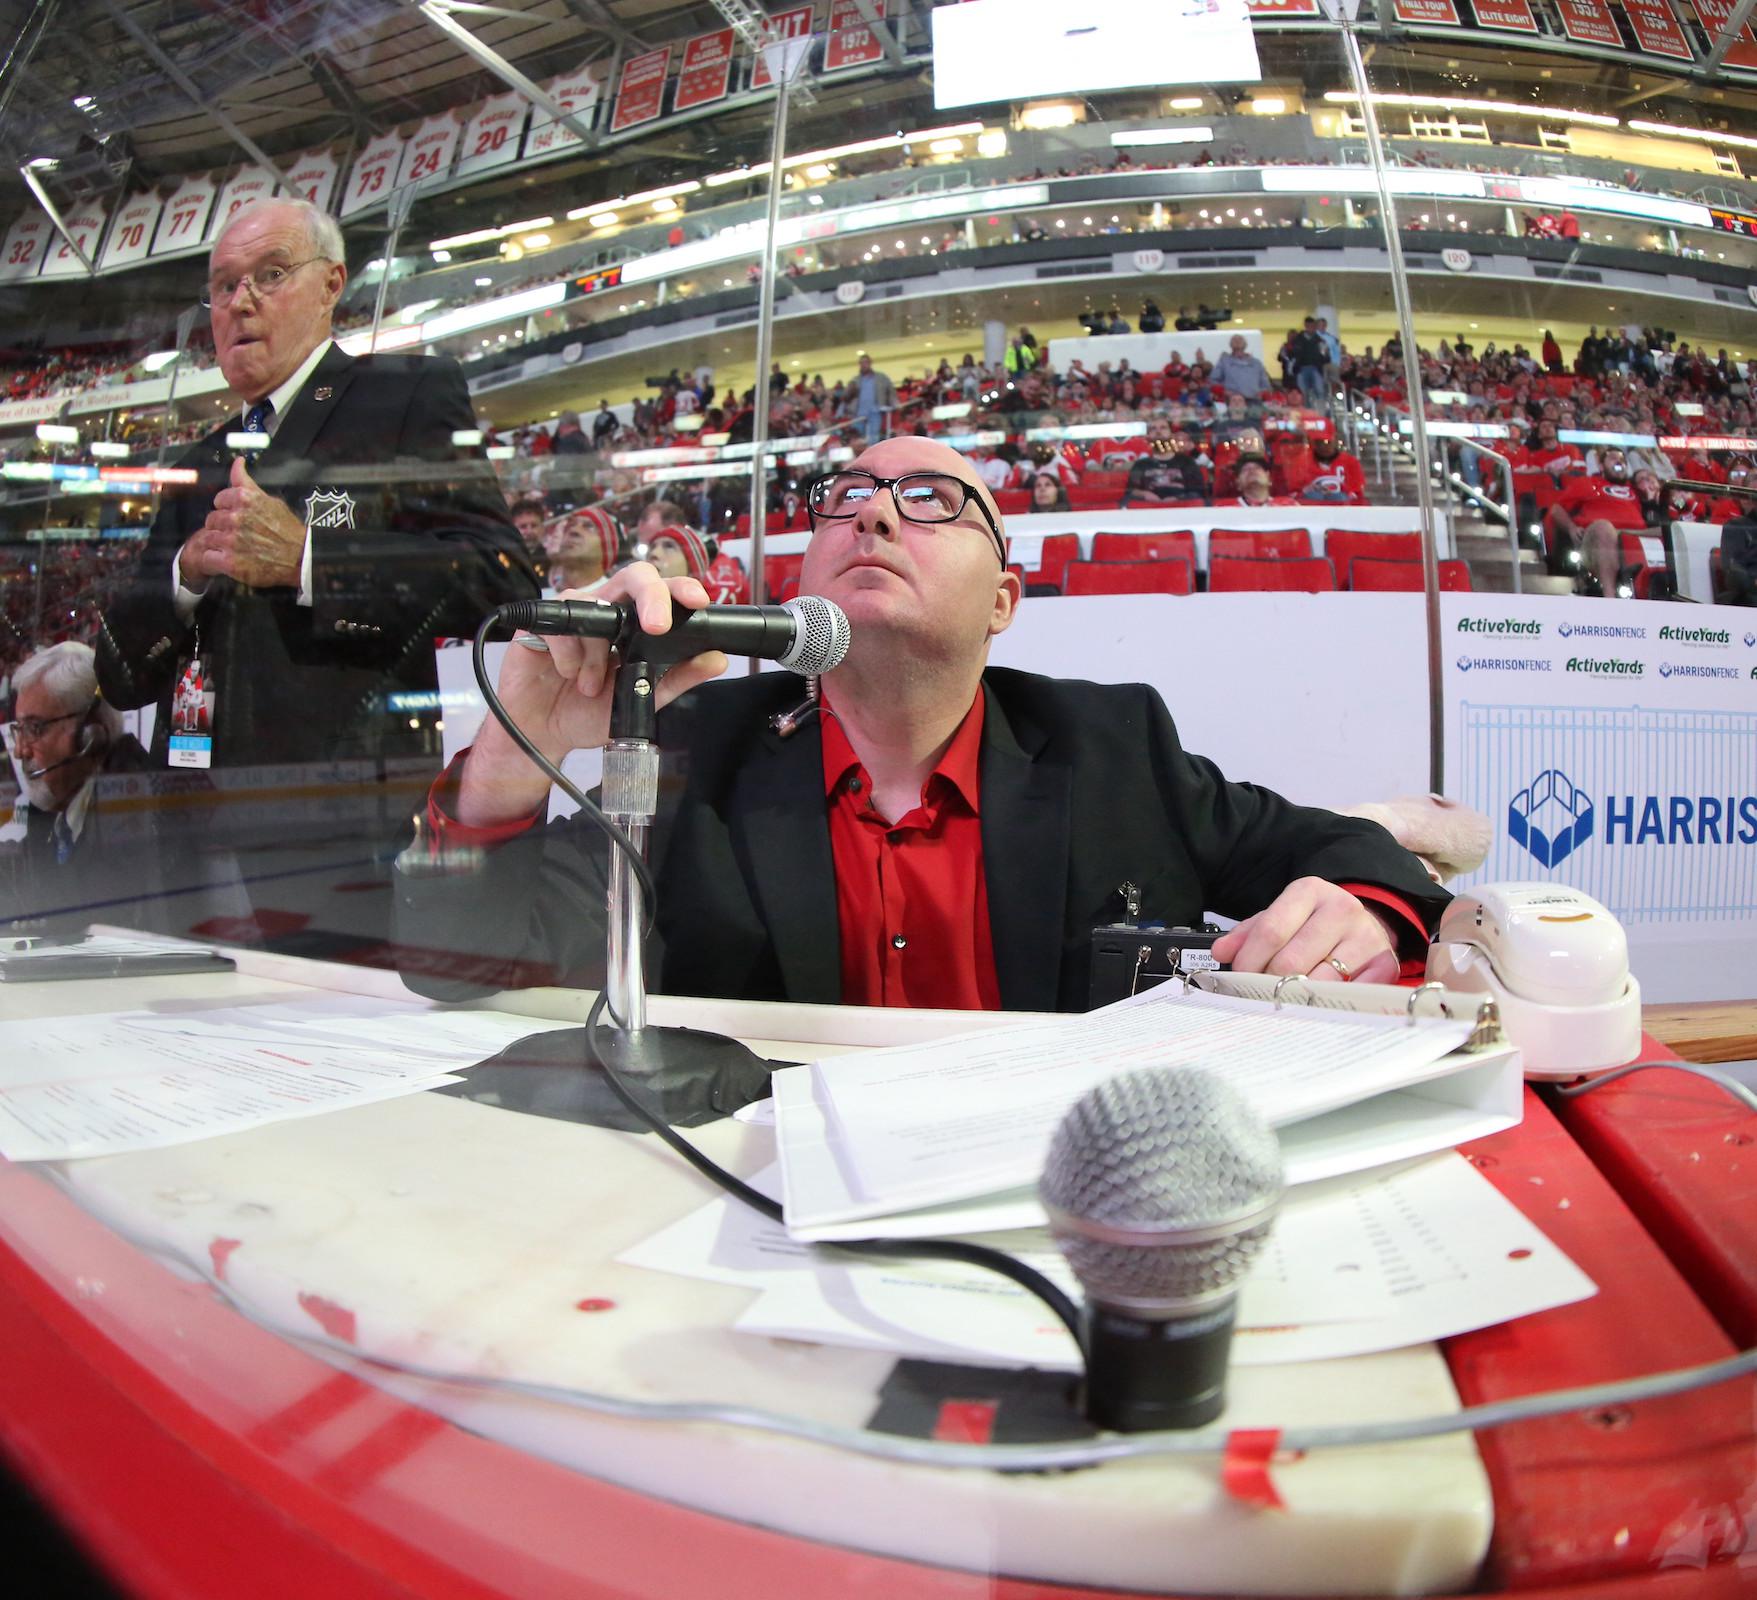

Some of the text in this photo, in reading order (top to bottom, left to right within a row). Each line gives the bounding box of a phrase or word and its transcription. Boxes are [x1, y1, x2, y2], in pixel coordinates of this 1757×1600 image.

[1479, 10, 1530, 25] ELITE EIGHT
[840, 30, 870, 50] 1973
[474, 126, 508, 155] 20
[409, 147, 442, 179] 24
[357, 166, 386, 197] 73
[168, 209, 198, 237] 77
[117, 223, 145, 251] 70
[8, 239, 36, 264] 32
[1137, 252, 1159, 266] 119
[1446, 252, 1467, 265] 120
[1335, 464, 1345, 483] C
[1457, 618, 1541, 634] ActiveYards
[1574, 625, 1647, 639] HARRISONFENCE
[1659, 626, 1730, 643] ActiveYards
[1473, 659, 1552, 672] HARRISONFENCE
[1566, 658, 1644, 674] ActiveYards
[1673, 665, 1740, 679] HARRISONFENCE
[1606, 795, 1757, 845] HARRIS
[1186, 953, 1213, 961] R-800
